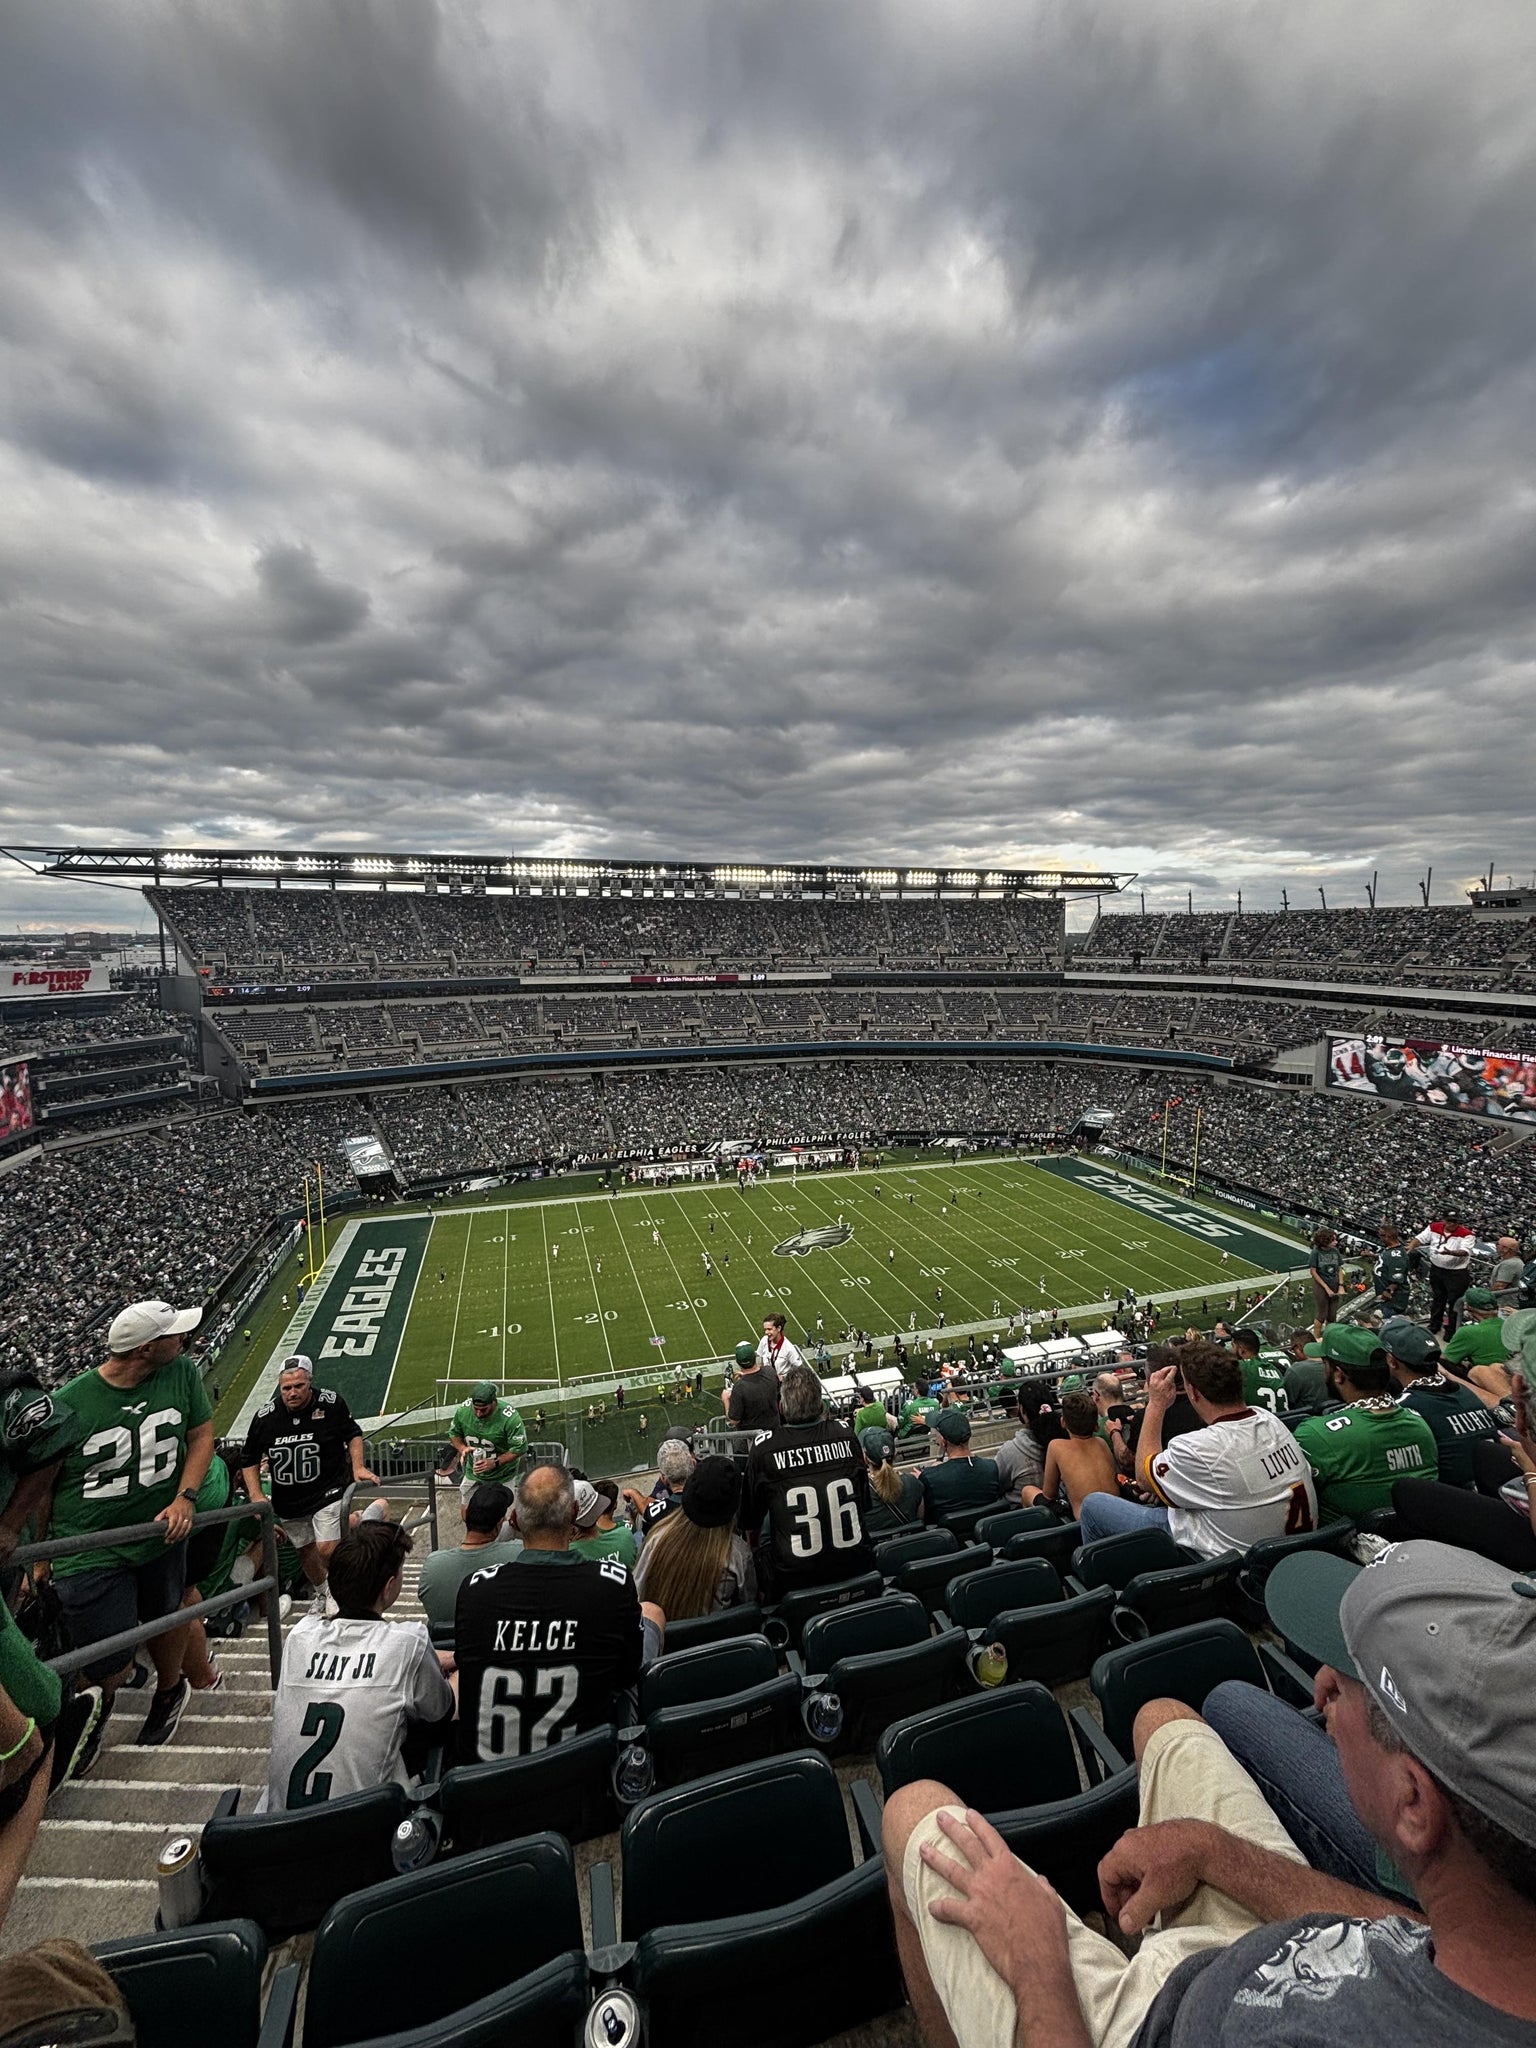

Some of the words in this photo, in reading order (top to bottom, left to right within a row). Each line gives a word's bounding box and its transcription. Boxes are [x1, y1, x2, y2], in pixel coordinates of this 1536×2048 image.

[48, 982, 84, 992] BANK
[1366, 1034, 1384, 1043] 2:09
[1451, 1045, 1481, 1056] Lincoln
[1481, 1049, 1521, 1061] Financial
[766, 1136, 833, 1146] PHILADELPHIA
[836, 1131, 871, 1141] EAGLES
[658, 1144, 698, 1155] EAGLES
[1074, 1174, 1244, 1237] EAGLES
[1214, 1189, 1256, 1210] FOUNDATION
[707, 1211, 732, 1219] 40
[772, 1204, 797, 1213] 50
[640, 1218, 666, 1227] 30
[568, 1225, 595, 1236] 20
[492, 1234, 518, 1243] 10
[1055, 1248, 1085, 1259] 20
[987, 1257, 1017, 1269] 30
[919, 1265, 947, 1278] 40
[840, 1276, 872, 1288] 50
[763, 1286, 792, 1299] 40
[318, 1247, 408, 1360] EAGLES
[675, 1297, 708, 1311] 30
[288, 1304, 315, 1334] TAKES
[584, 1310, 618, 1324] 20
[489, 1323, 522, 1337] 10
[280, 1337, 298, 1347] IT
[502, 1405, 516, 1418] 62
[275, 1432, 315, 1446] EAGLES
[82, 1407, 182, 1499] 26
[773, 1440, 854, 1470] WESTBROOK
[1386, 1444, 1423, 1471] SMITH
[268, 1443, 321, 1485] 26
[1260, 1443, 1300, 1480] LUVU
[1284, 1480, 1314, 1536] 4
[786, 1477, 862, 1558] 36
[493, 1619, 578, 1652] KELCE
[305, 1651, 351, 1681] SLAY
[352, 1652, 376, 1680] JR
[477, 1664, 580, 1762] 62
[286, 1701, 345, 1811] 2
